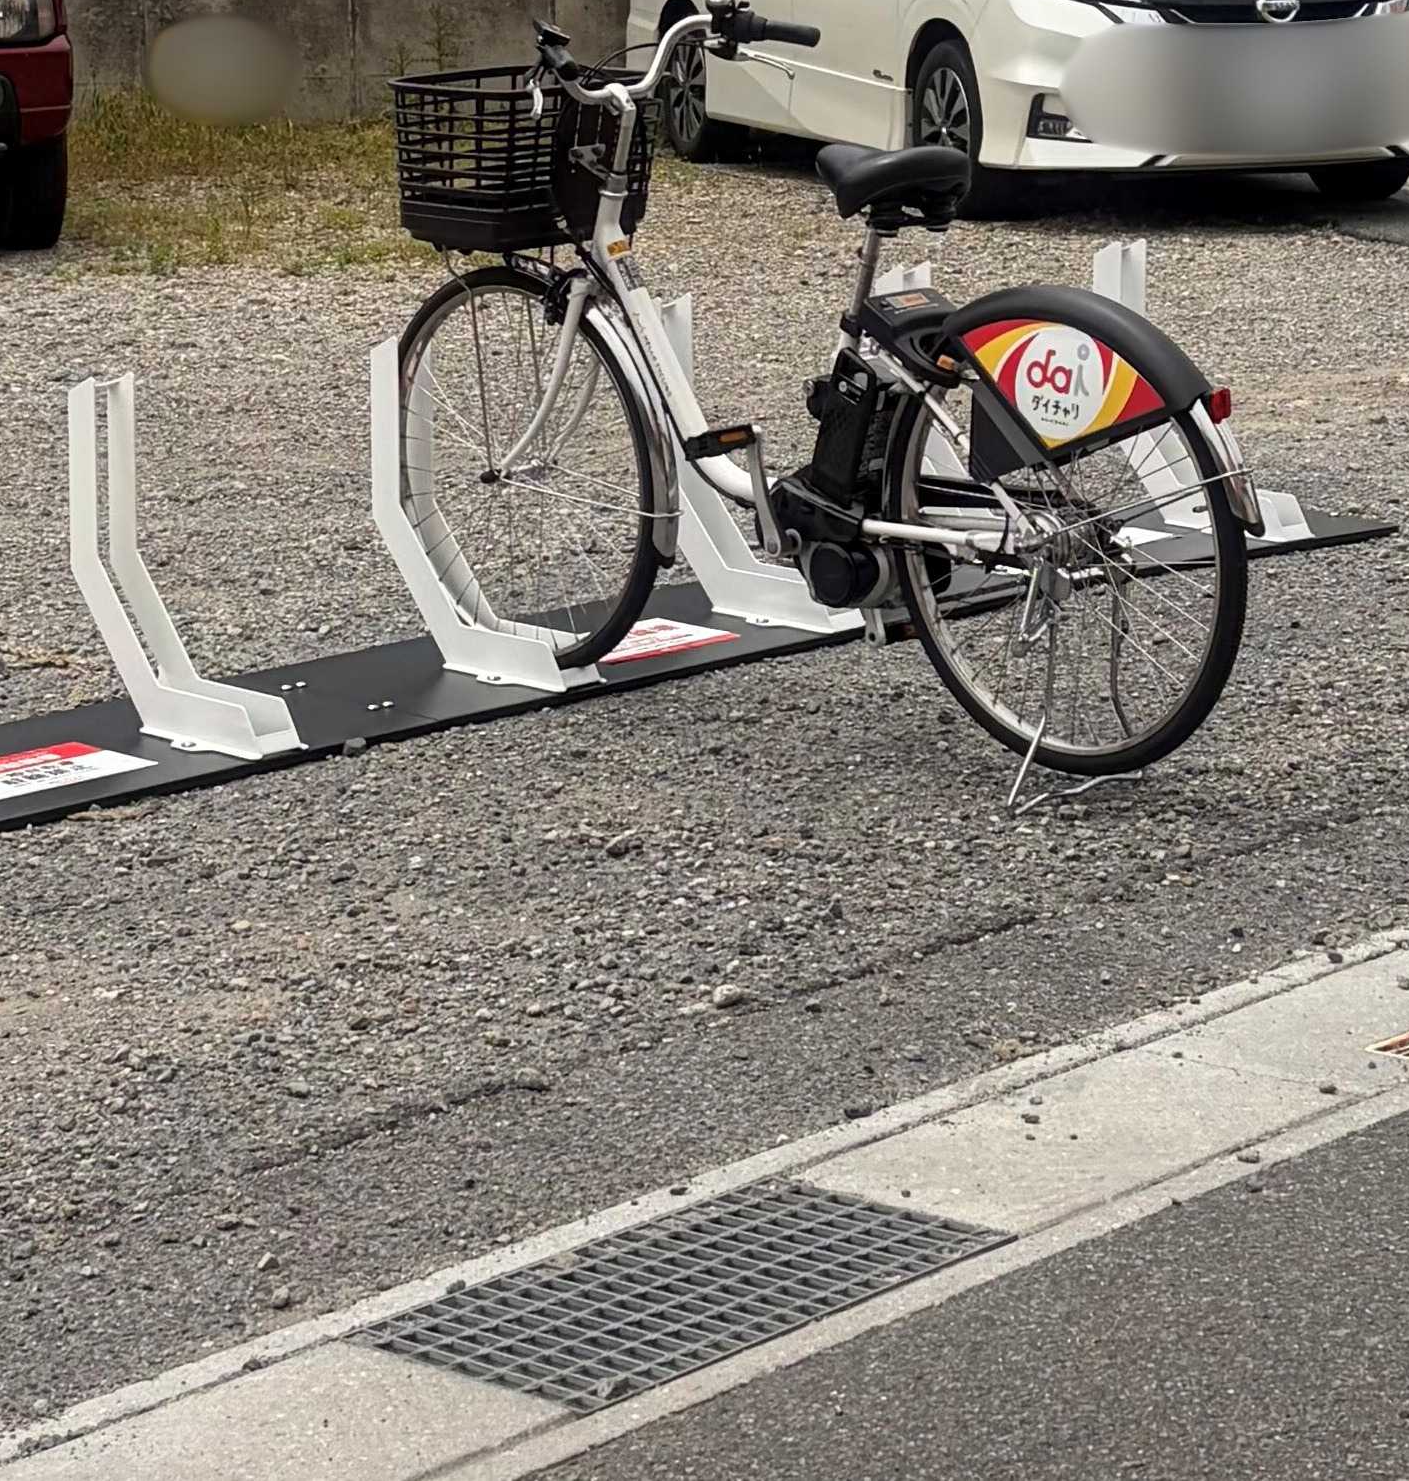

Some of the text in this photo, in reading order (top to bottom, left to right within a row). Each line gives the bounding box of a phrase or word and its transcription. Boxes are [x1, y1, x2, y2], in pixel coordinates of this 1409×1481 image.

[1026, 343, 1090, 395] dai
[1031, 395, 1080, 420] ダイチャリ
